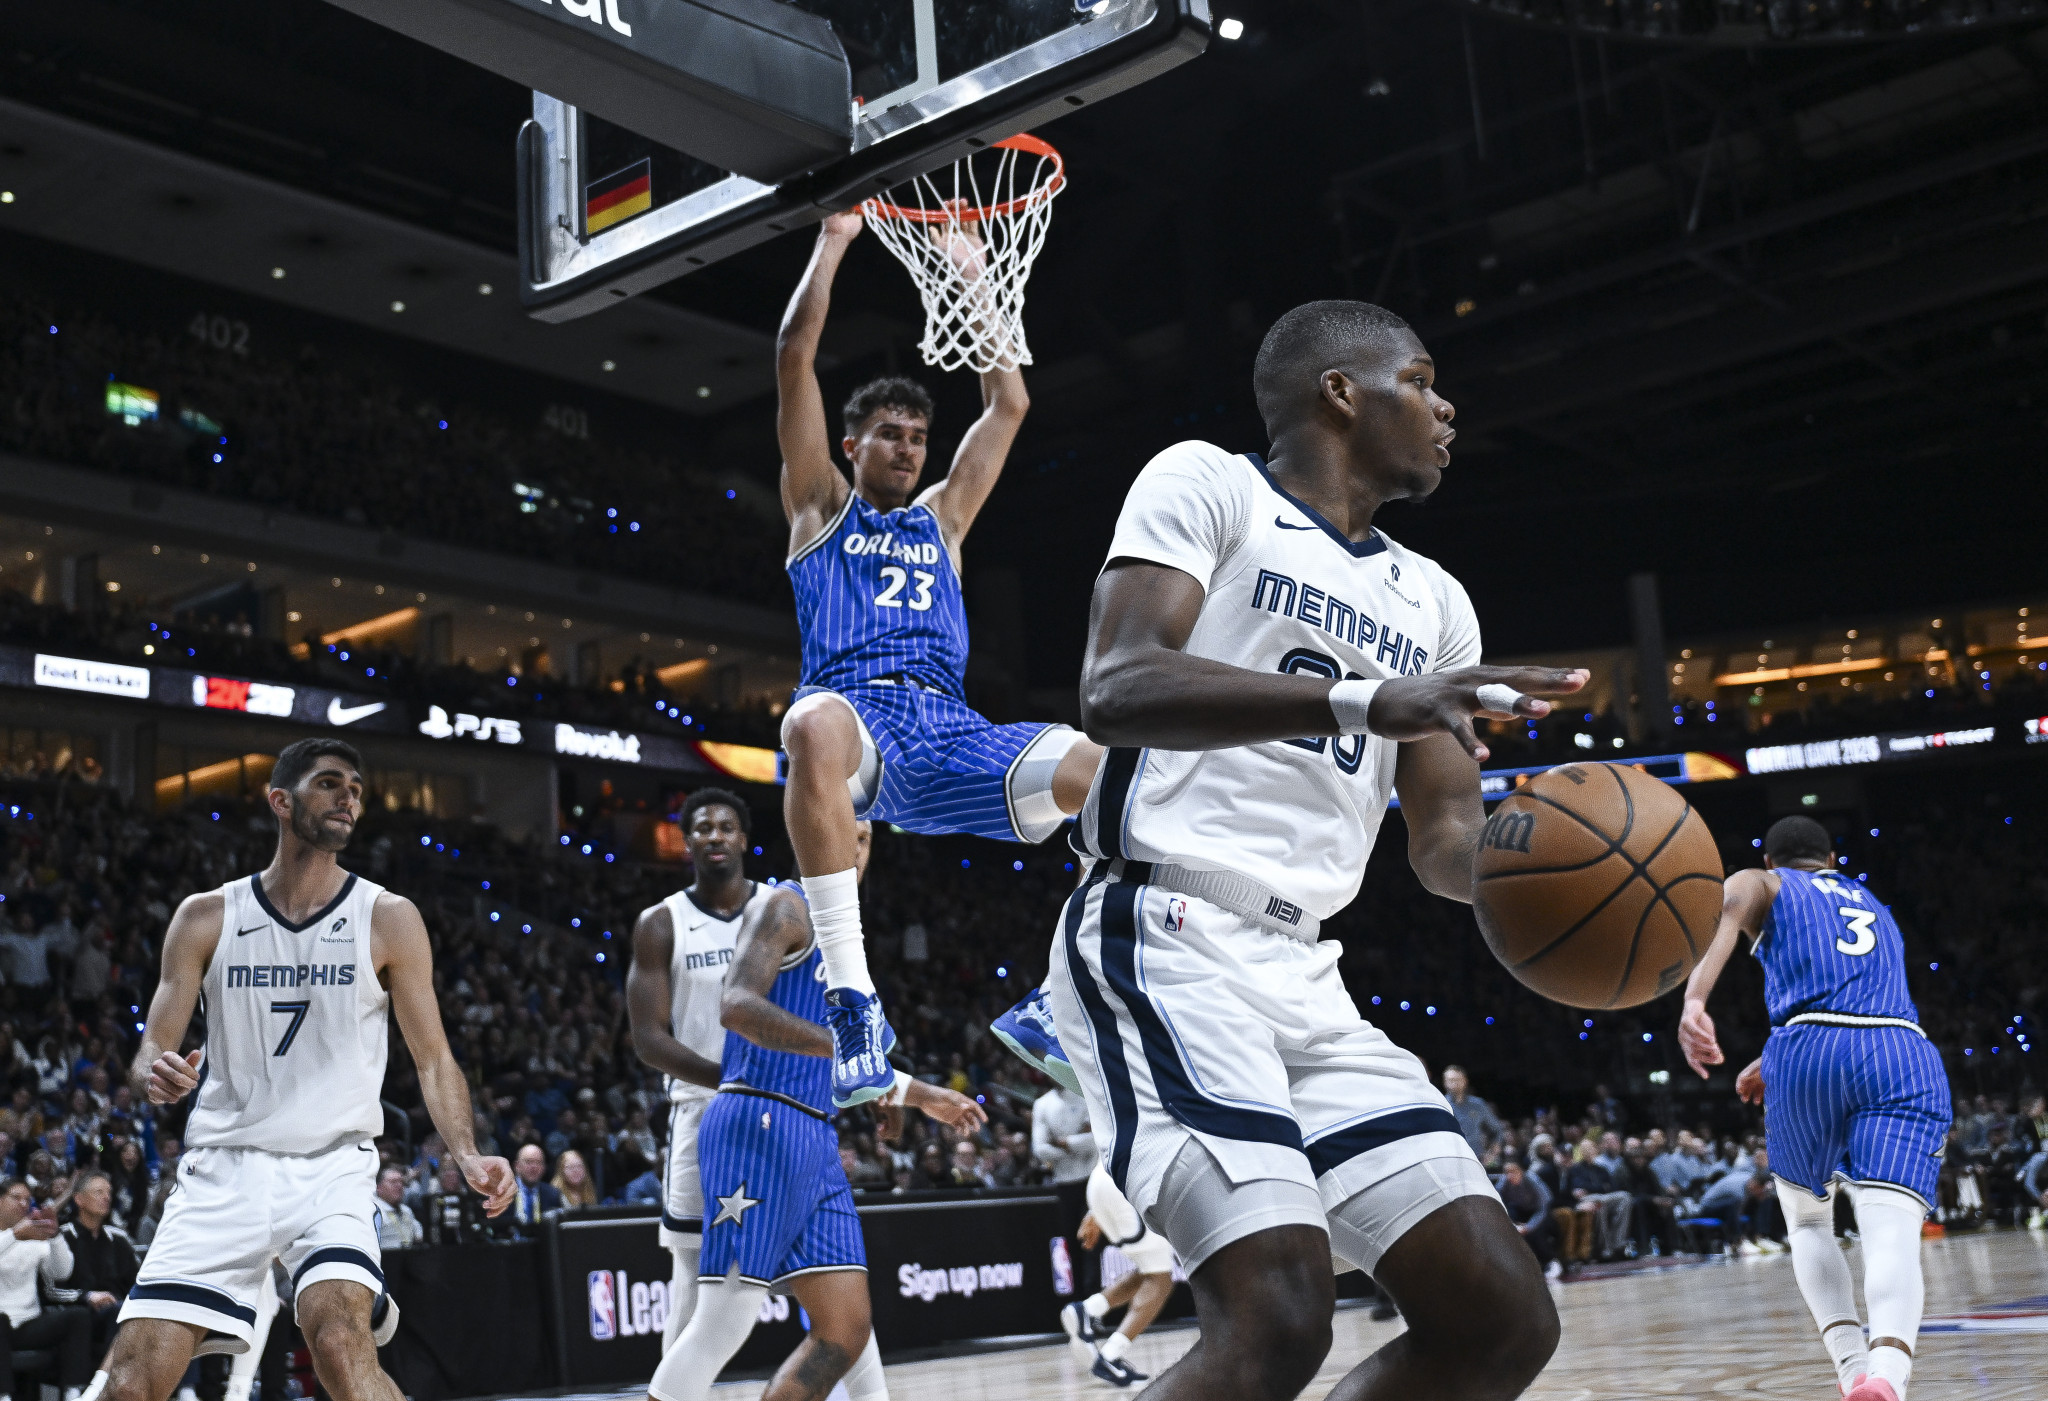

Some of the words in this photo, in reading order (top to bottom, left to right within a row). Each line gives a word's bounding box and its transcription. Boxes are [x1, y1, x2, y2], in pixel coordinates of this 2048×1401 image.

[189, 312, 249, 355] 402
[874, 566, 935, 611] 23
[1251, 568, 1428, 677] MEMPHIS
[454, 712, 522, 744] PS5
[554, 722, 641, 763] Revolut
[1836, 906, 1877, 956] 3
[227, 964, 355, 988] MEMPHIS
[270, 1000, 311, 1057] 7
[616, 1269, 674, 1336] Lea
[898, 1262, 949, 1302] Sign
[949, 1265, 979, 1298] up
[979, 1262, 1023, 1290] now
